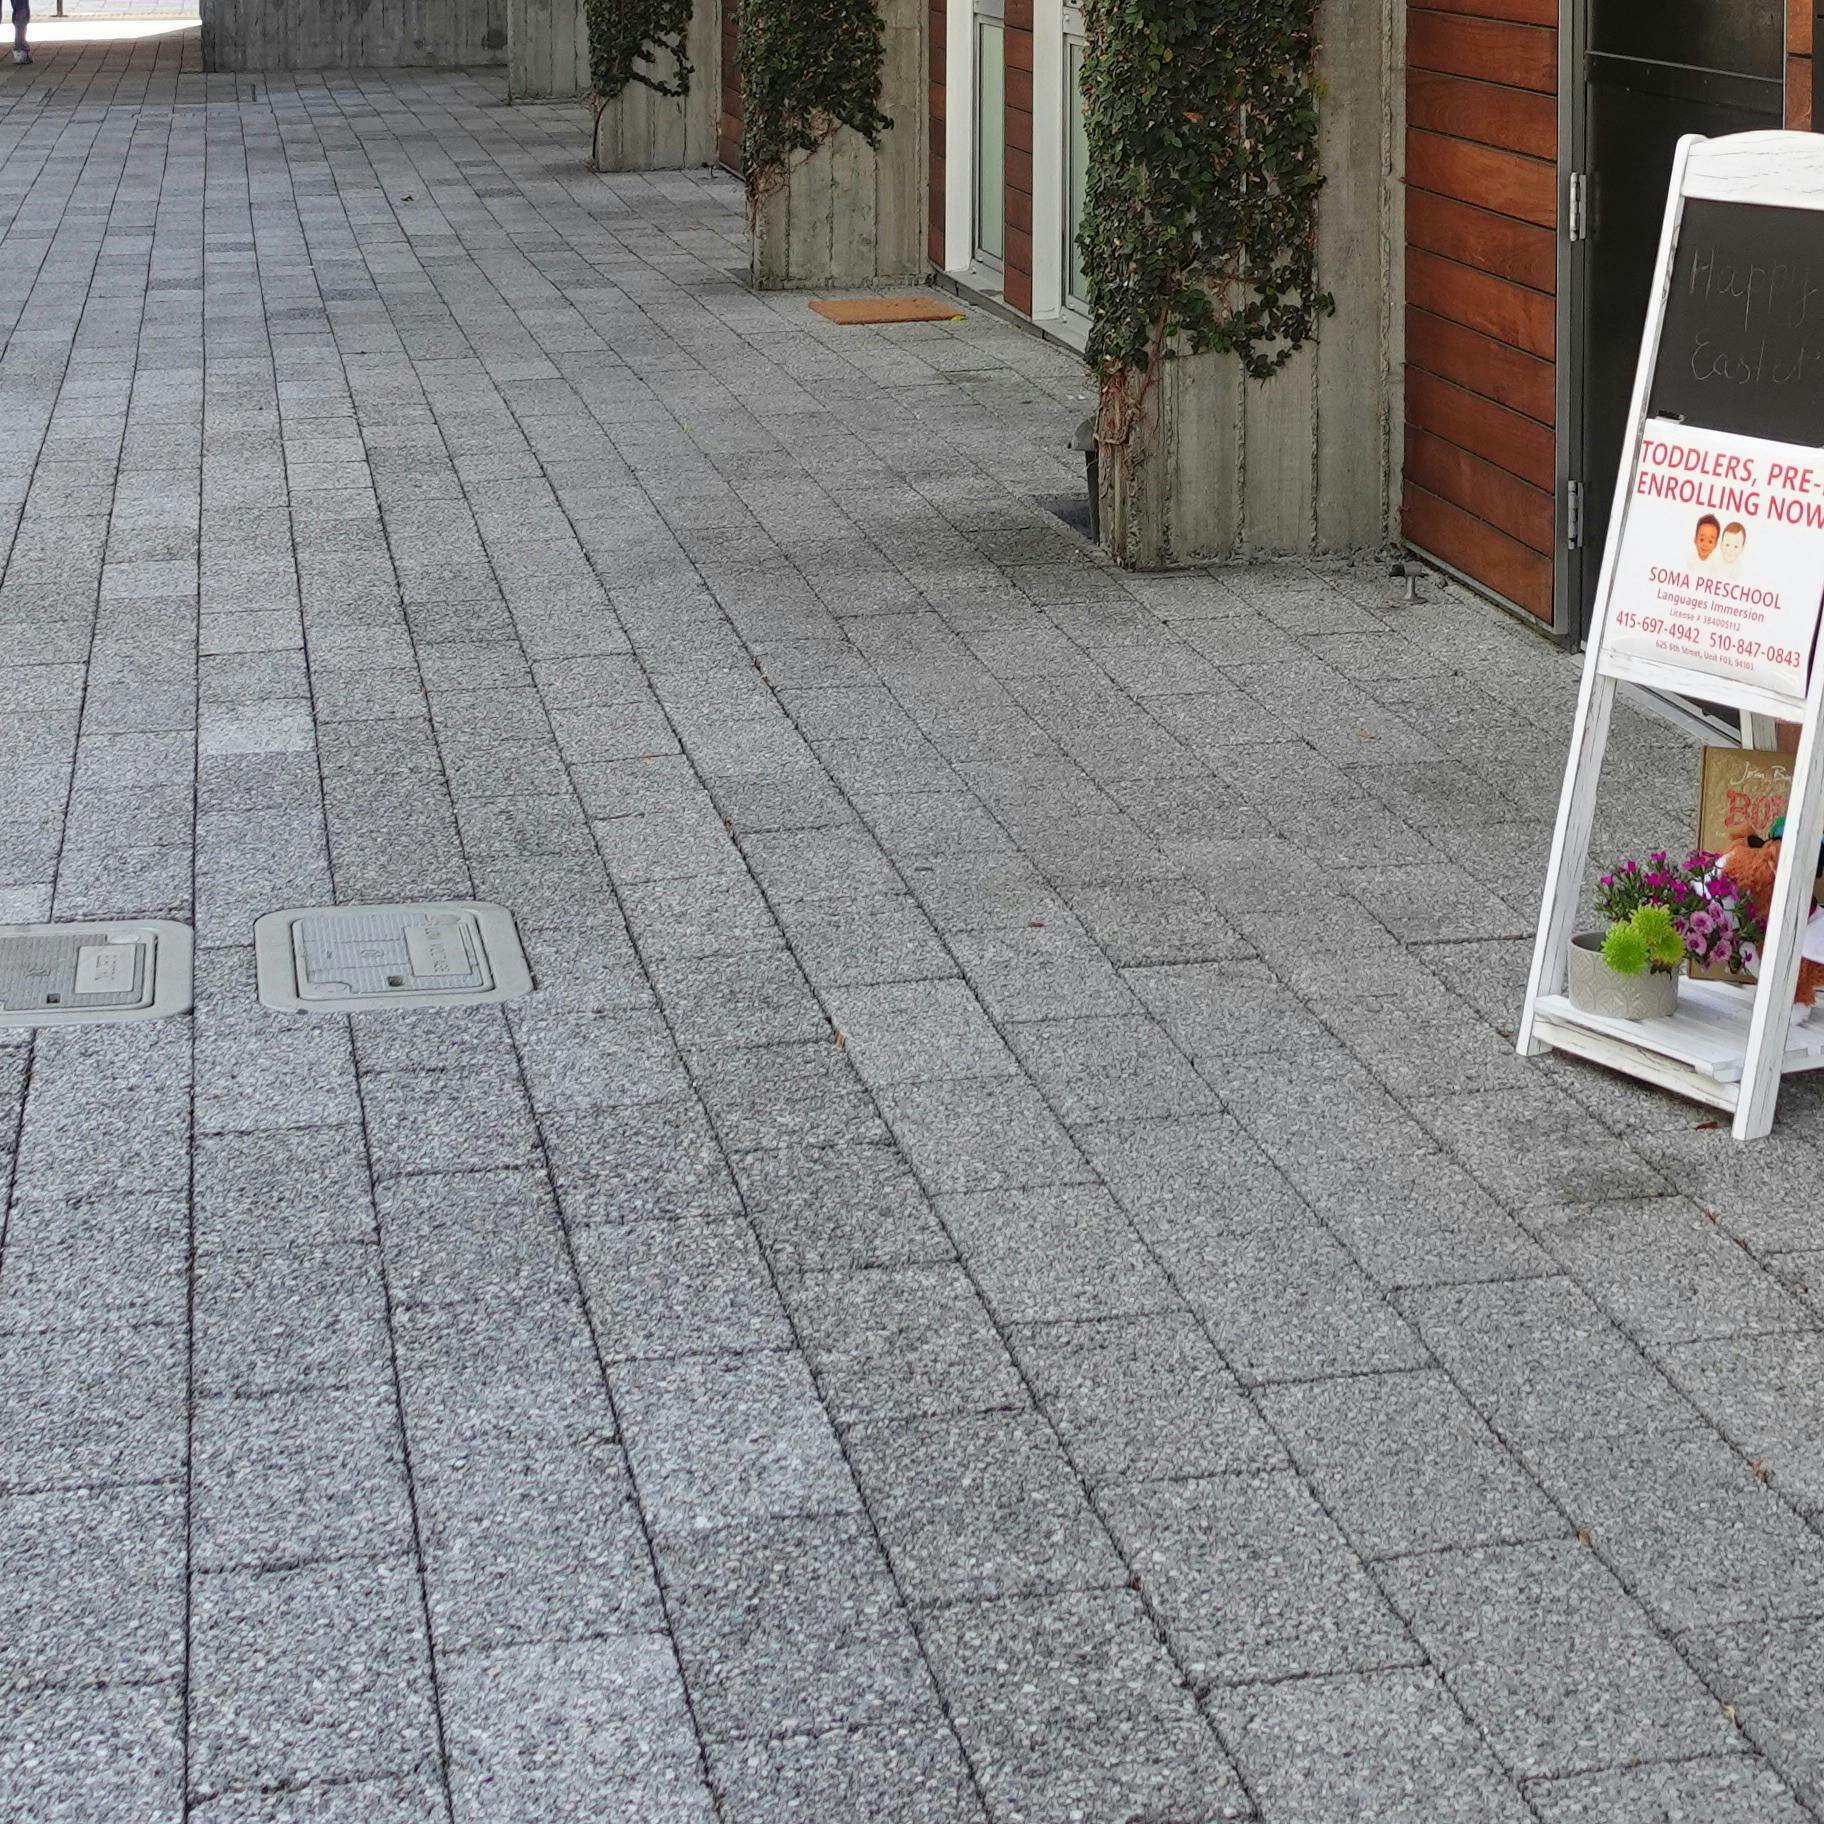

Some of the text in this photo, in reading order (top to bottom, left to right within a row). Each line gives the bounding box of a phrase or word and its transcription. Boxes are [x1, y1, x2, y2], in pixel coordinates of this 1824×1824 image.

[1689, 248, 1819, 332] Happy
[1643, 440, 1756, 487] TODDLERS,
[1636, 471, 1760, 516] ENROLLING
[1648, 566, 1782, 610] SOMA PRESCHOOL
[1657, 588, 1764, 623] Languages Immersion
[1615, 610, 1801, 668] 415-697-4942 510-847-0843
